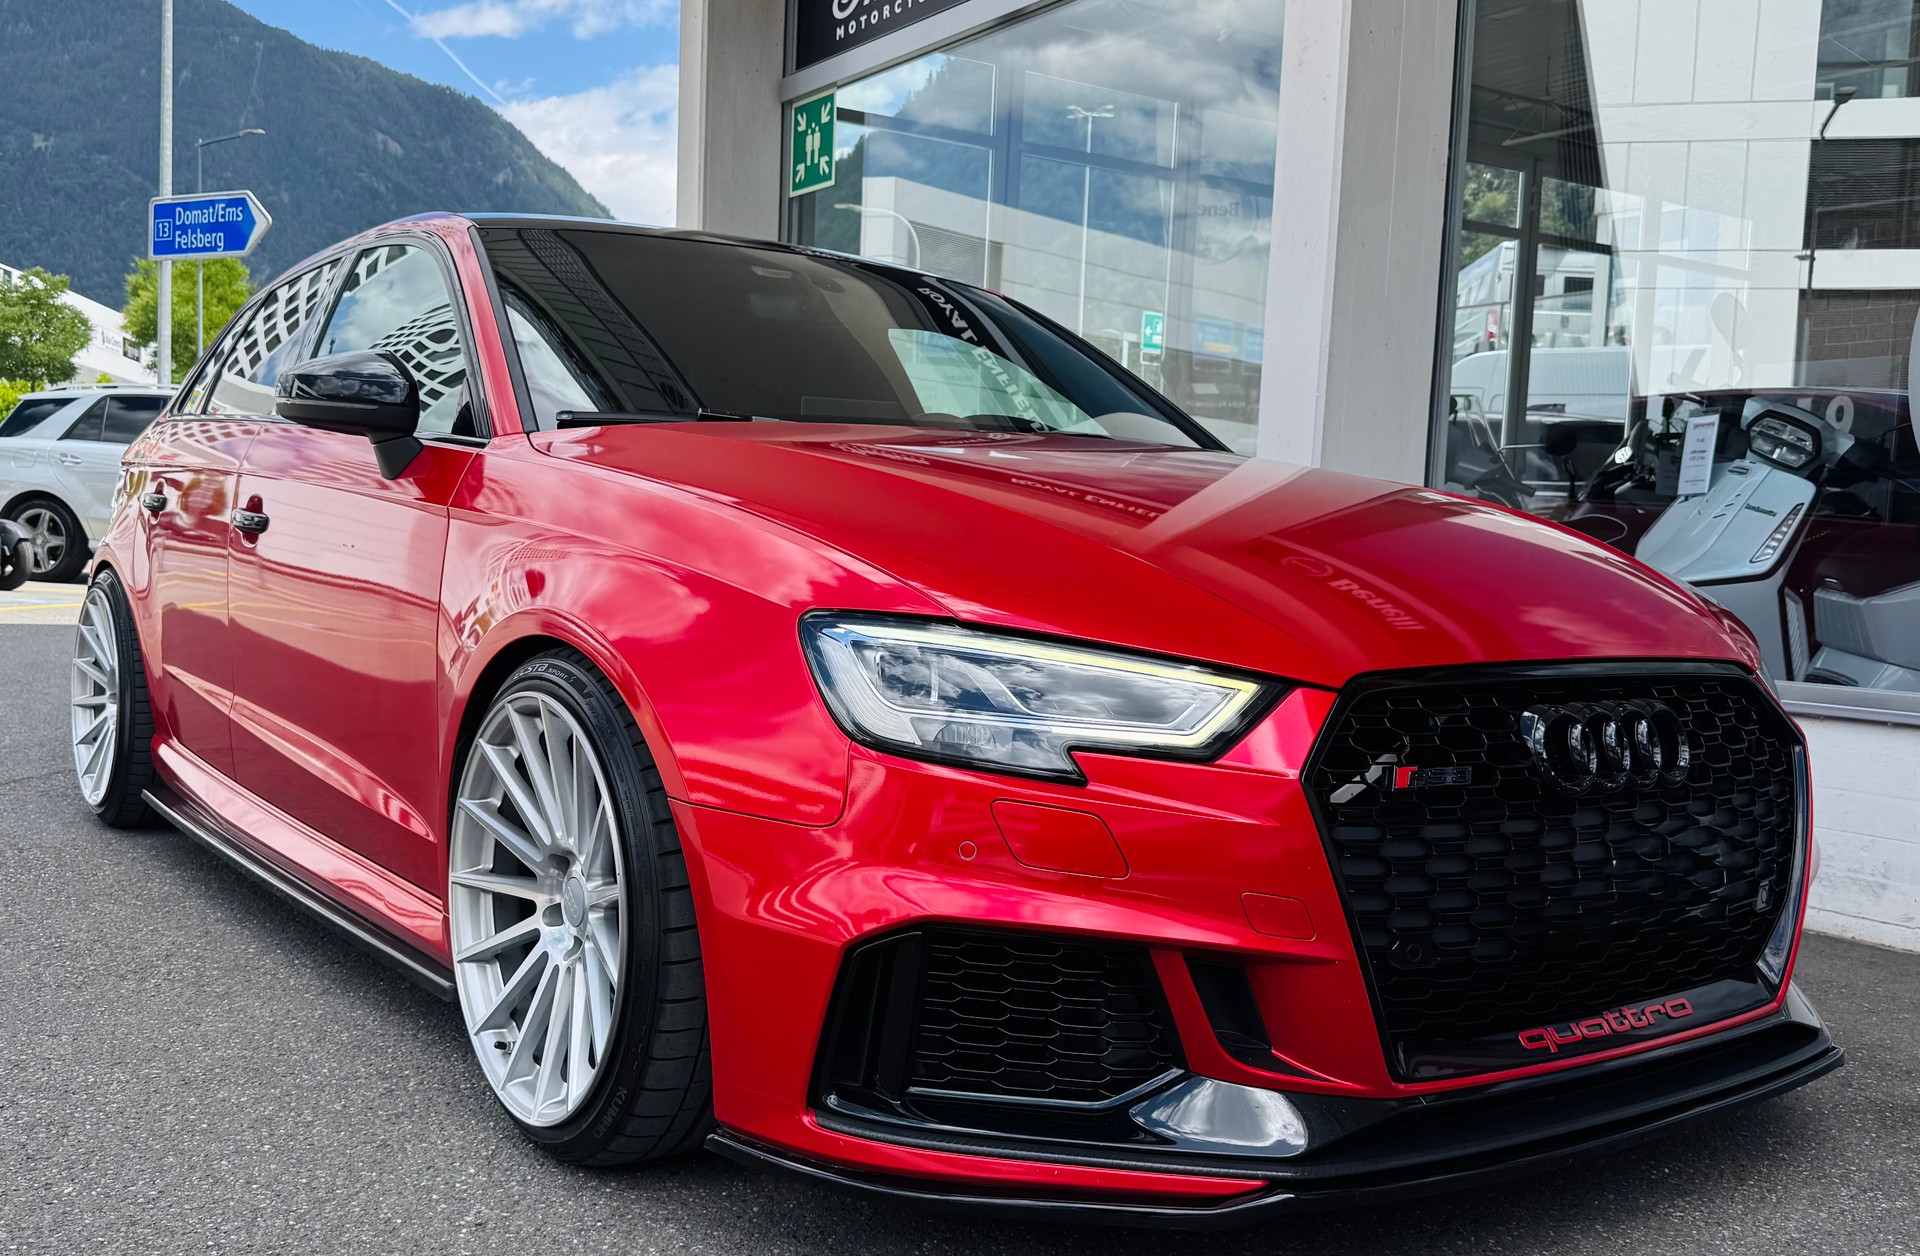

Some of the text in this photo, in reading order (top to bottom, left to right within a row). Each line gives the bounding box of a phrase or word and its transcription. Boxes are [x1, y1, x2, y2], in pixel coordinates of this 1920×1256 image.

[175, 204, 243, 225] Domat/Ems
[158, 222, 170, 238] 13
[175, 228, 224, 252] Felsberg
[547, 668, 568, 680] SPORT
[1518, 997, 1694, 1053] quattro
[593, 1086, 628, 1138] KUMHO
